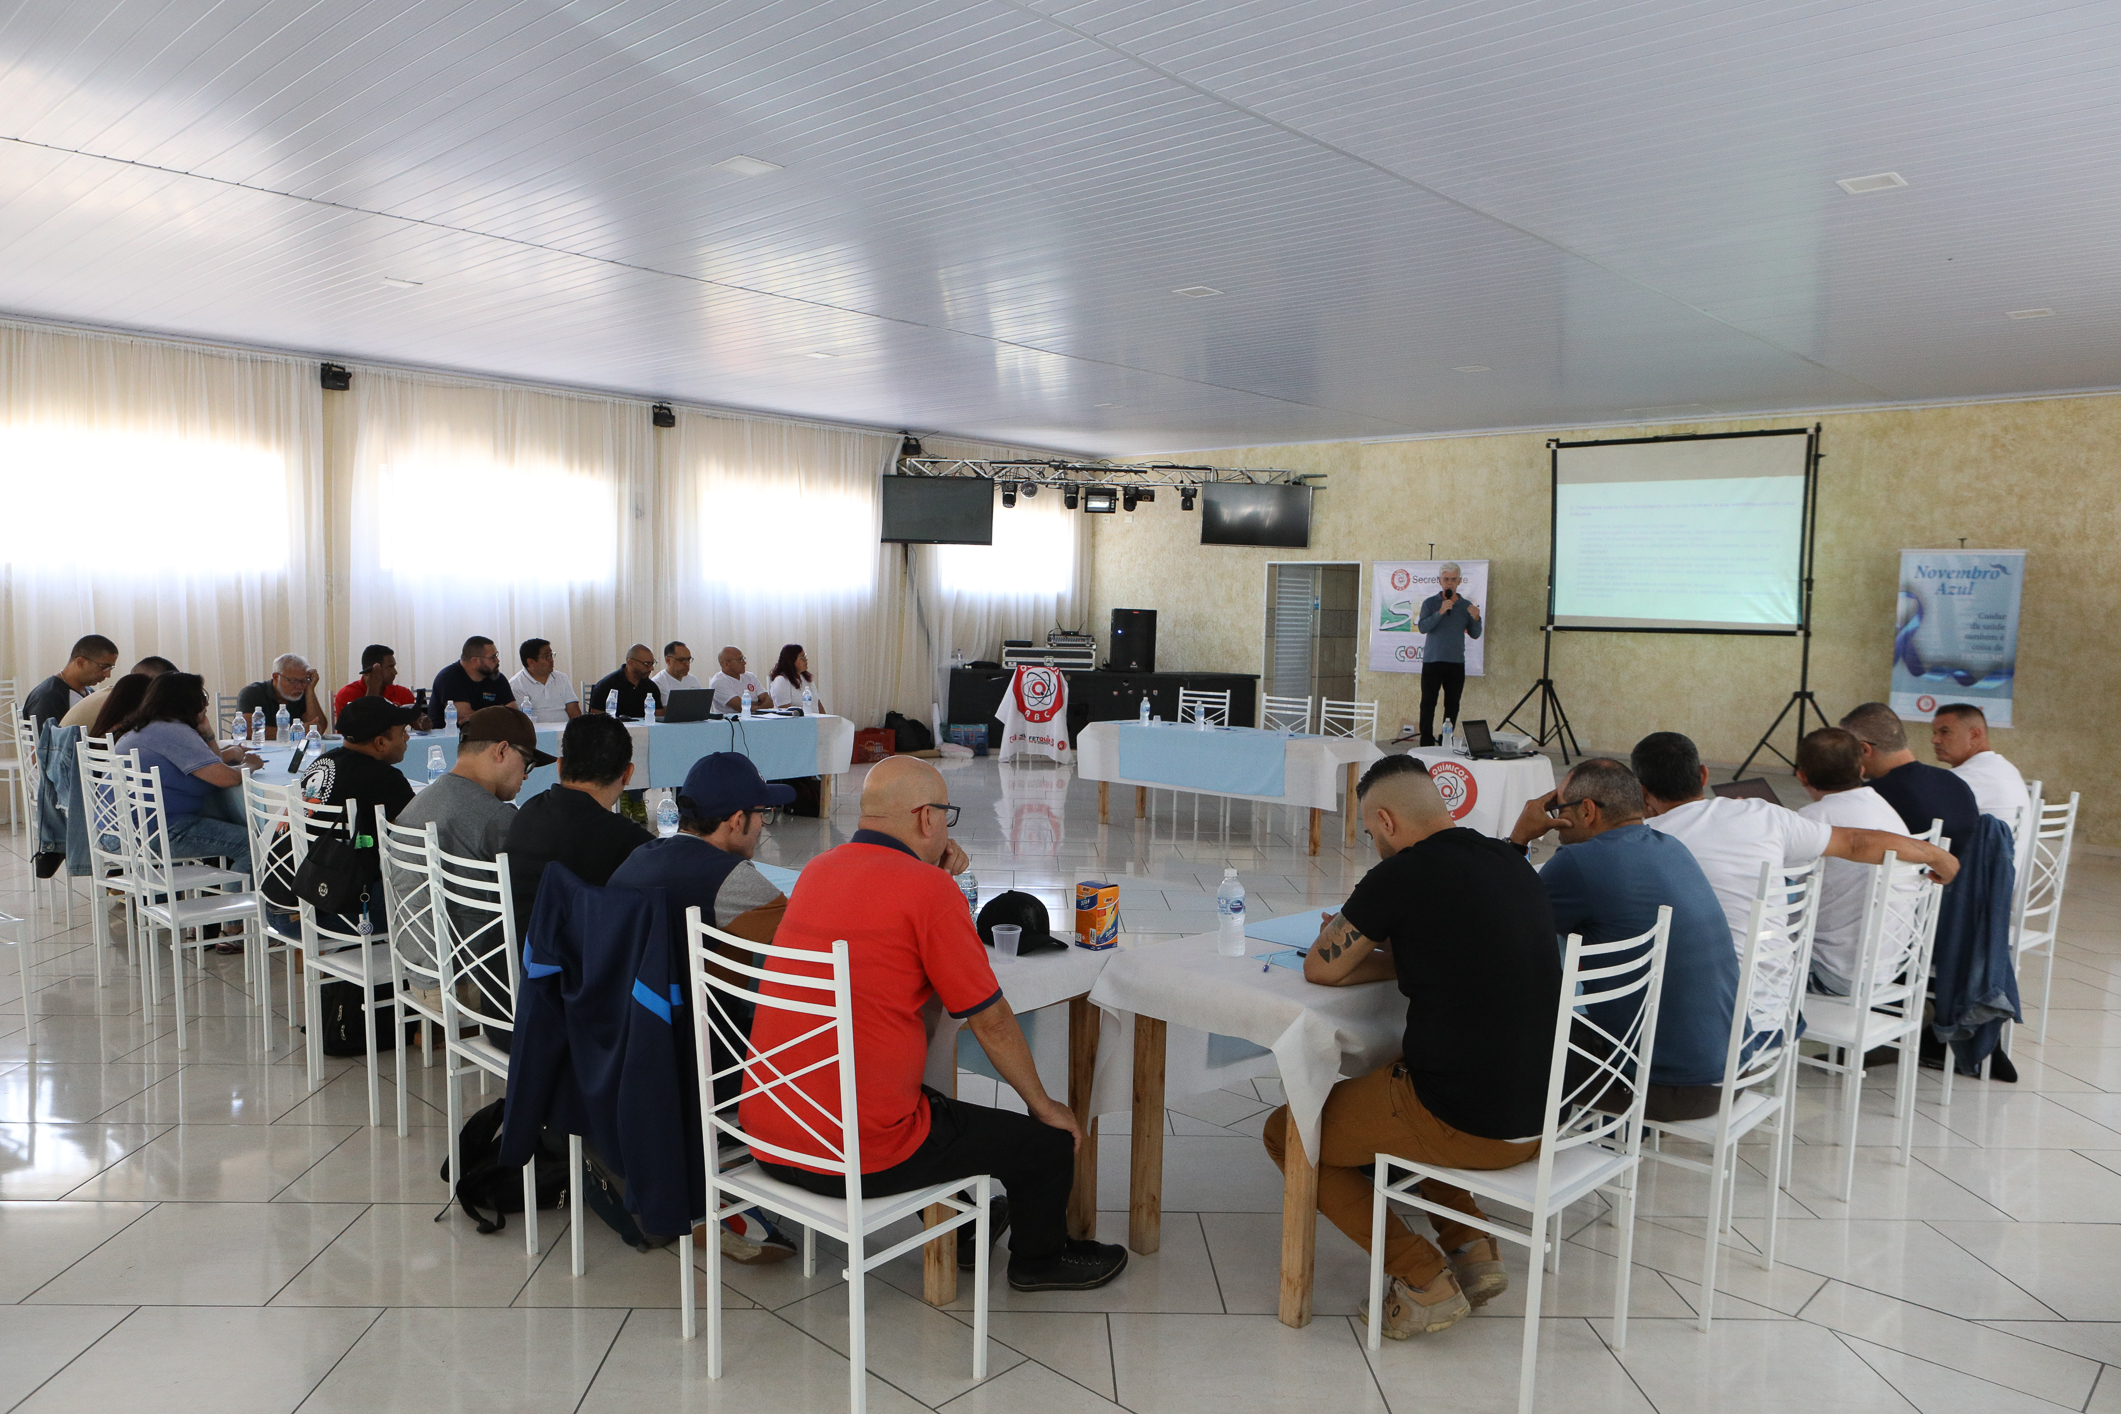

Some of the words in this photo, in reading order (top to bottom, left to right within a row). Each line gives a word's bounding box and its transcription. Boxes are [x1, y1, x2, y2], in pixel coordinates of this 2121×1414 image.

[1915, 566, 2000, 579] Novembro
[1412, 575, 1440, 584] Secret
[1934, 581, 1975, 595] Azul
[1431, 763, 1469, 781] QUÍMICOS
